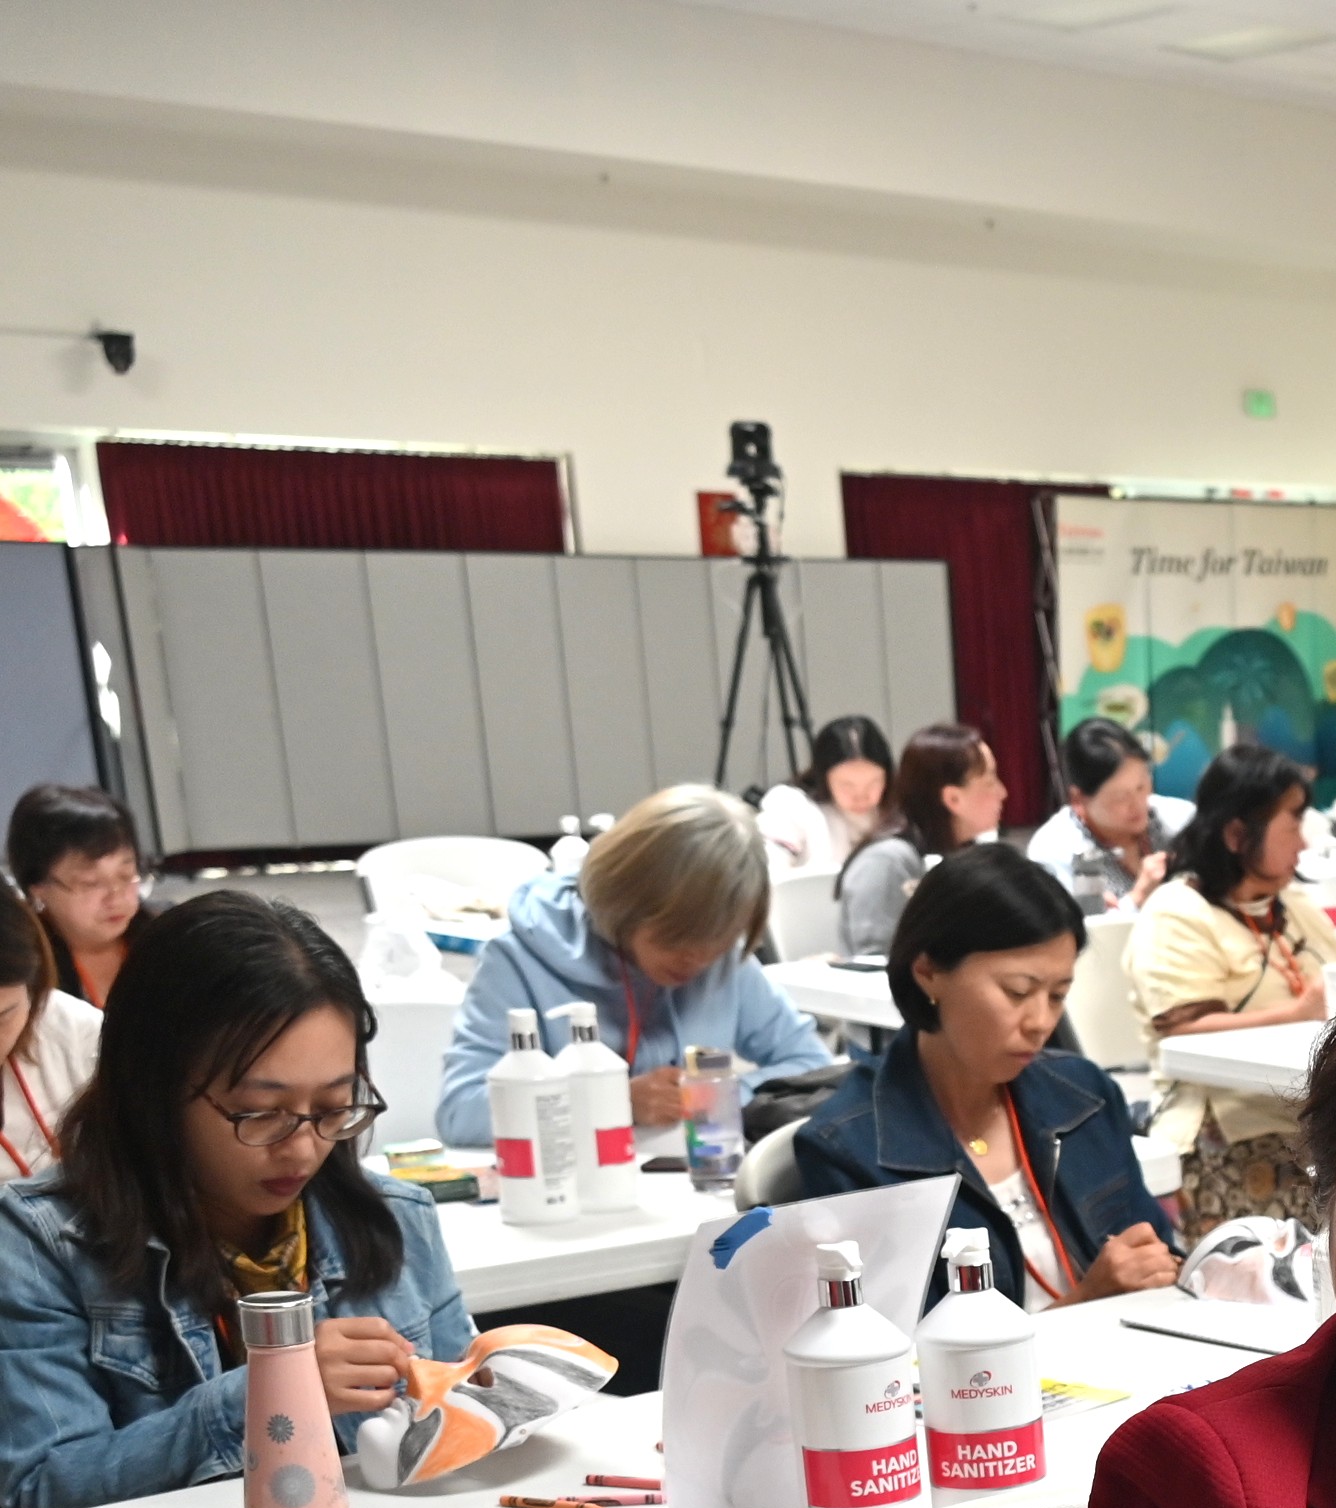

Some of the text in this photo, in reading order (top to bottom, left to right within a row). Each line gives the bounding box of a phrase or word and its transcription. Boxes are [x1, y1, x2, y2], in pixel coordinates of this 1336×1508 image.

[1129, 547, 1191, 576] Time
[1195, 549, 1235, 582] for
[1242, 549, 1329, 577] Taiwan
[951, 1384, 1013, 1400] MEDYSKIN
[872, 1449, 917, 1476] HAND
[957, 1440, 1018, 1460] HAND
[941, 1454, 1036, 1479] SANITIZER
